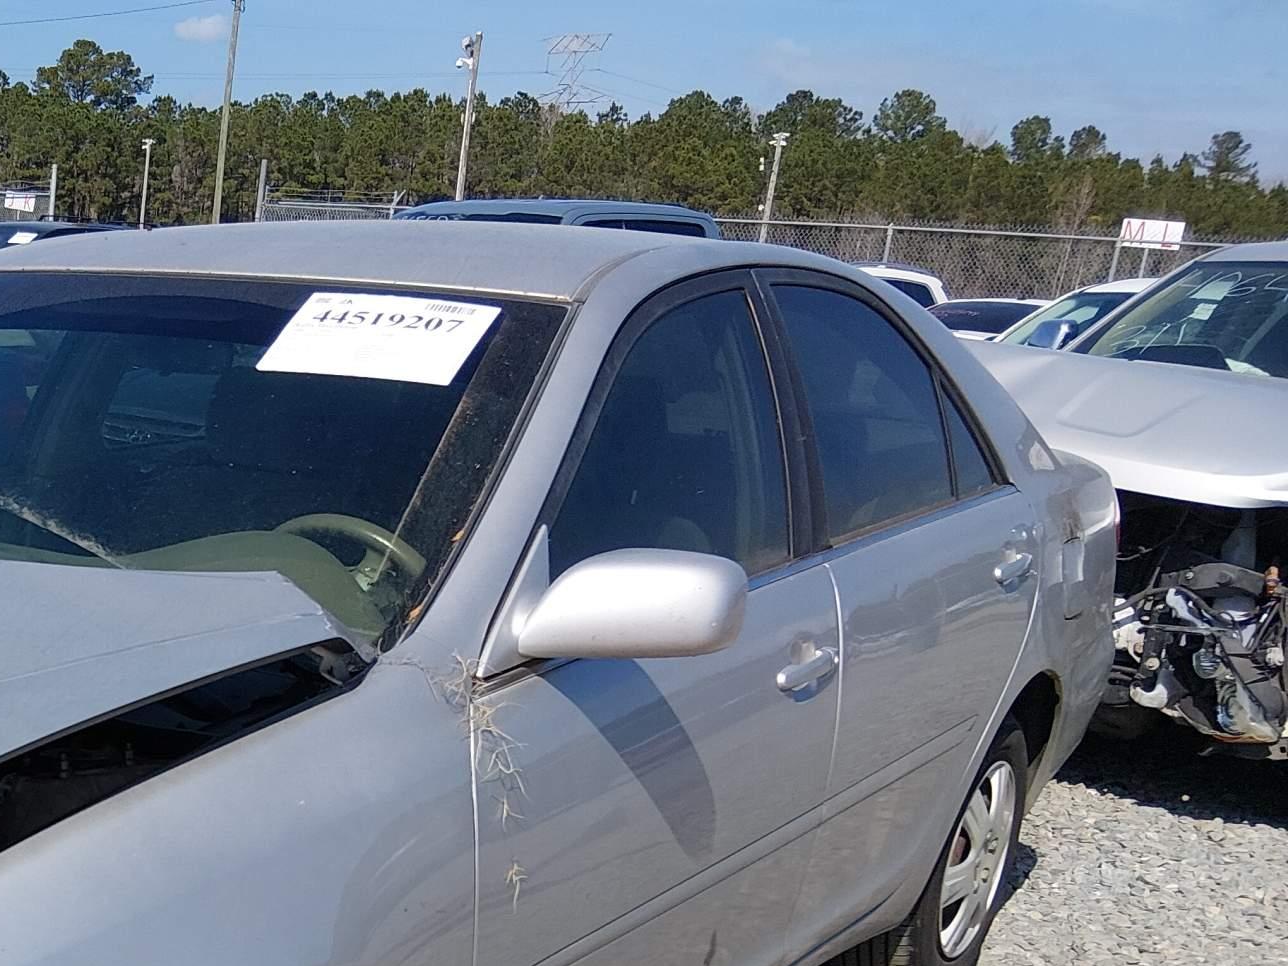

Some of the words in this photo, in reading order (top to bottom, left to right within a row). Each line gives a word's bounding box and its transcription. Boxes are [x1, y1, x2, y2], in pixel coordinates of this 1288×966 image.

[1120, 220, 1146, 246] M
[1160, 222, 1173, 248] L
[312, 309, 465, 334] 44519207
